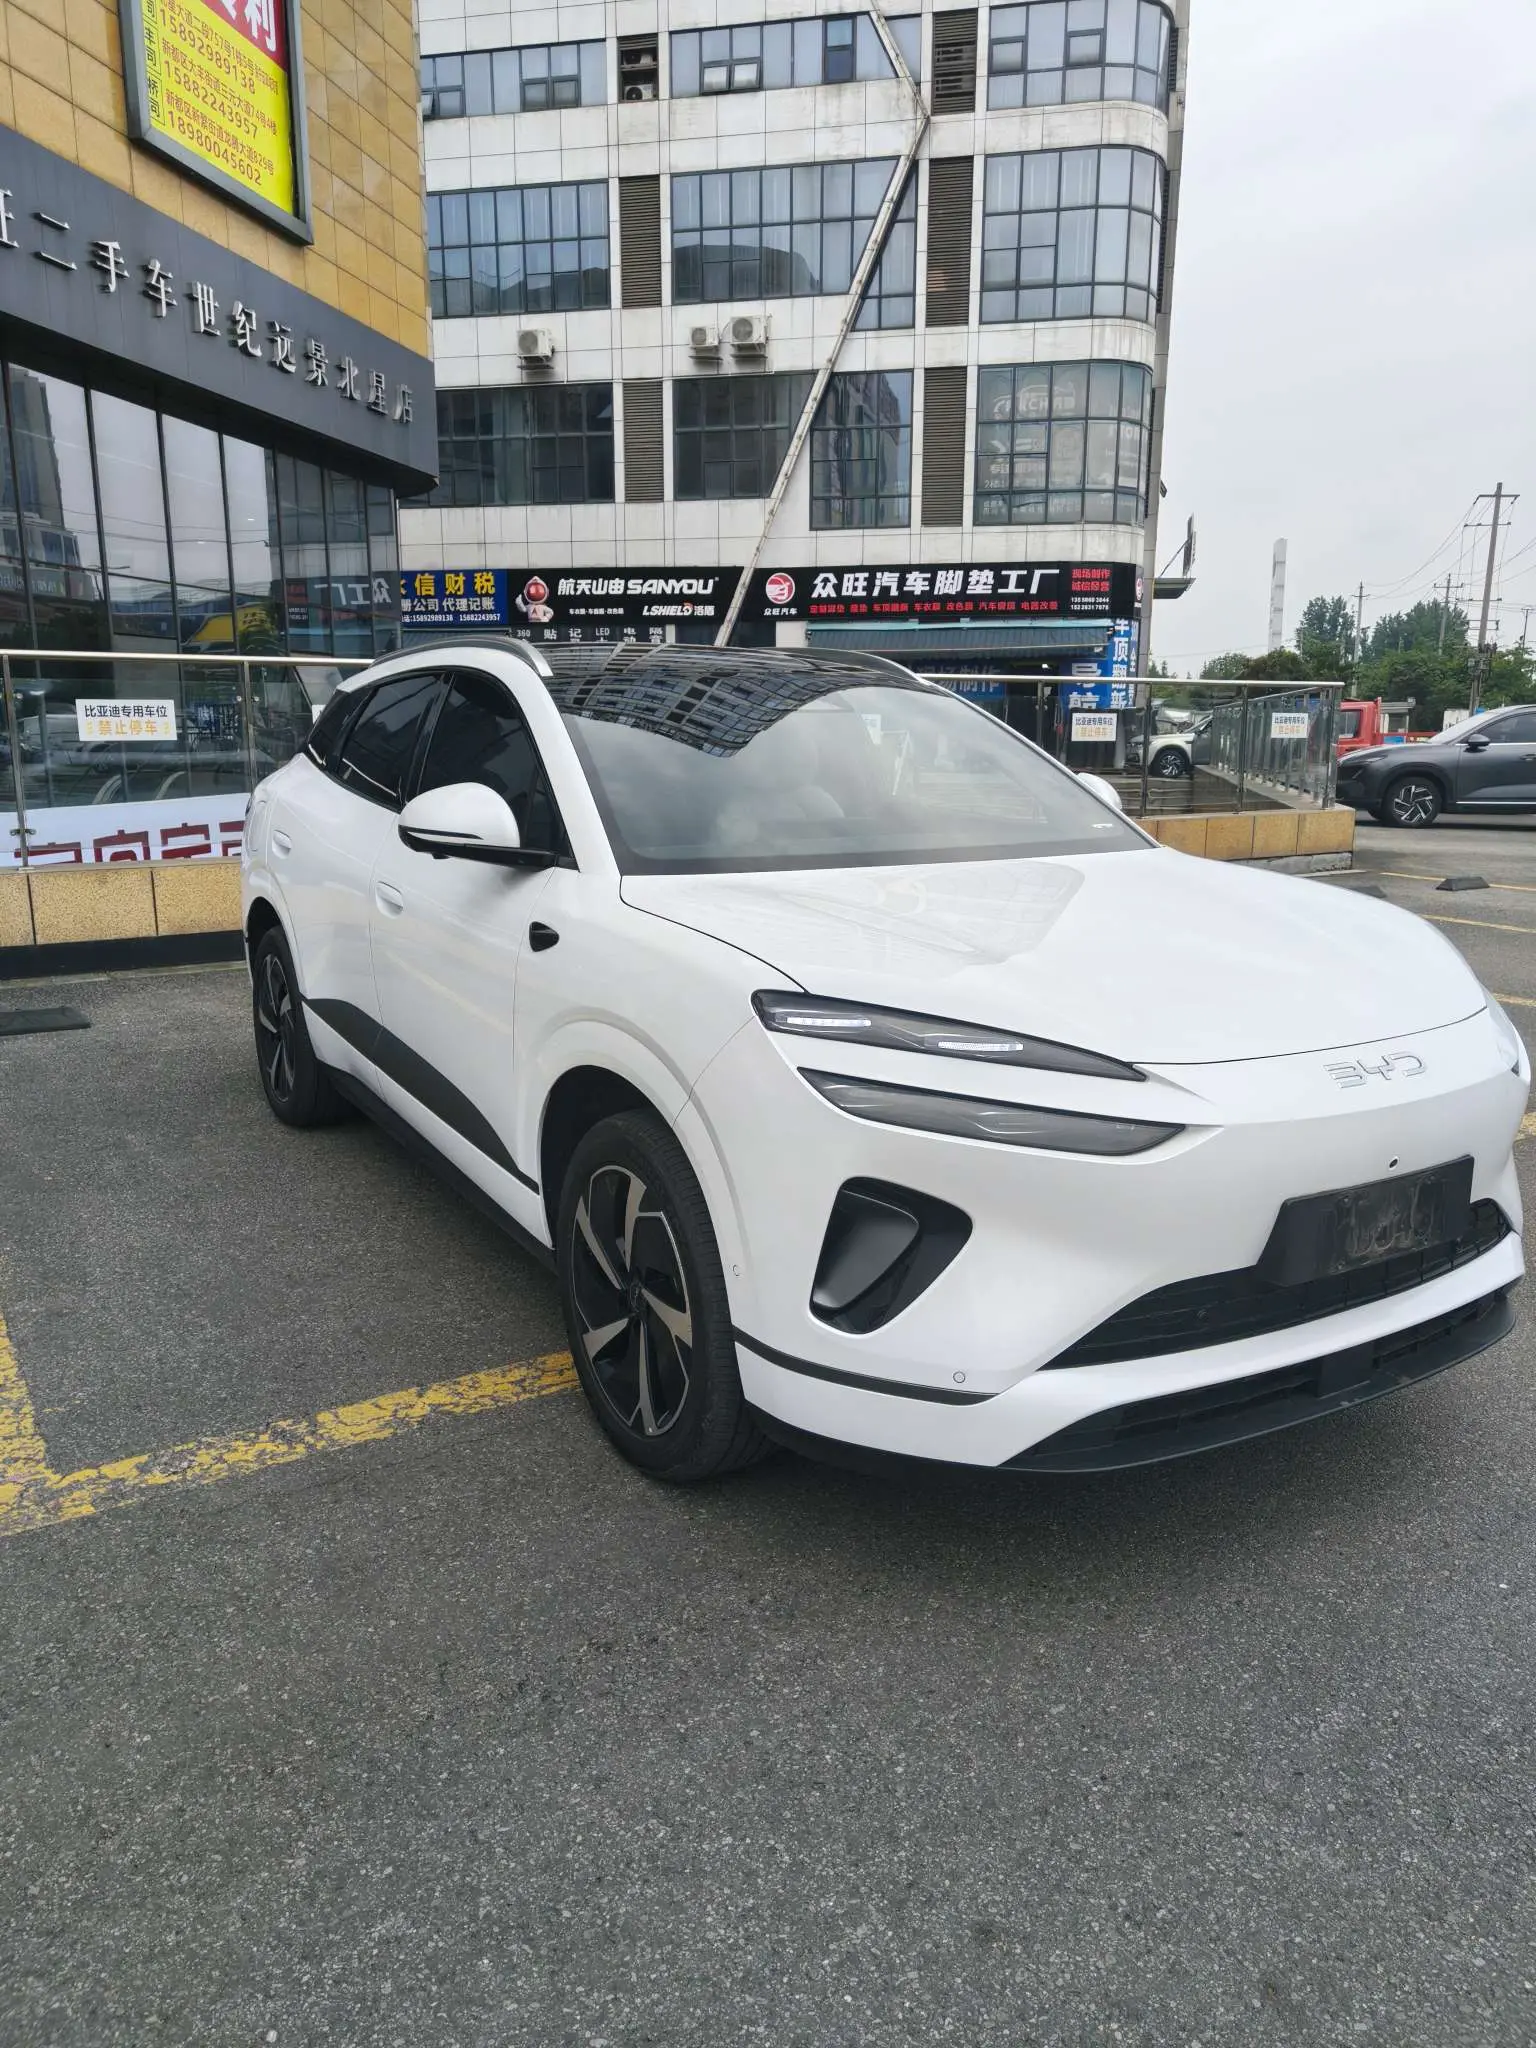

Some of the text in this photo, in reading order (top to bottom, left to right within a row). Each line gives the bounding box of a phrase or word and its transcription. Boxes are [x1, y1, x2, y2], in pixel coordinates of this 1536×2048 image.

[160, 8, 256, 95] 15892989138
[164, 60, 259, 139] 15882243957
[168, 110, 262, 186] 18980045602
[627, 578, 715, 596] SANYOU
[810, 568, 1060, 598] 众旺汽车脚垫工厂
[442, 596, 495, 612] 代理记账
[763, 607, 798, 617] 众旺汽车
[84, 705, 168, 718] 比亚迪专用车位
[98, 720, 157, 735] 禁止停车
[1322, 1050, 1428, 1089] BYD
